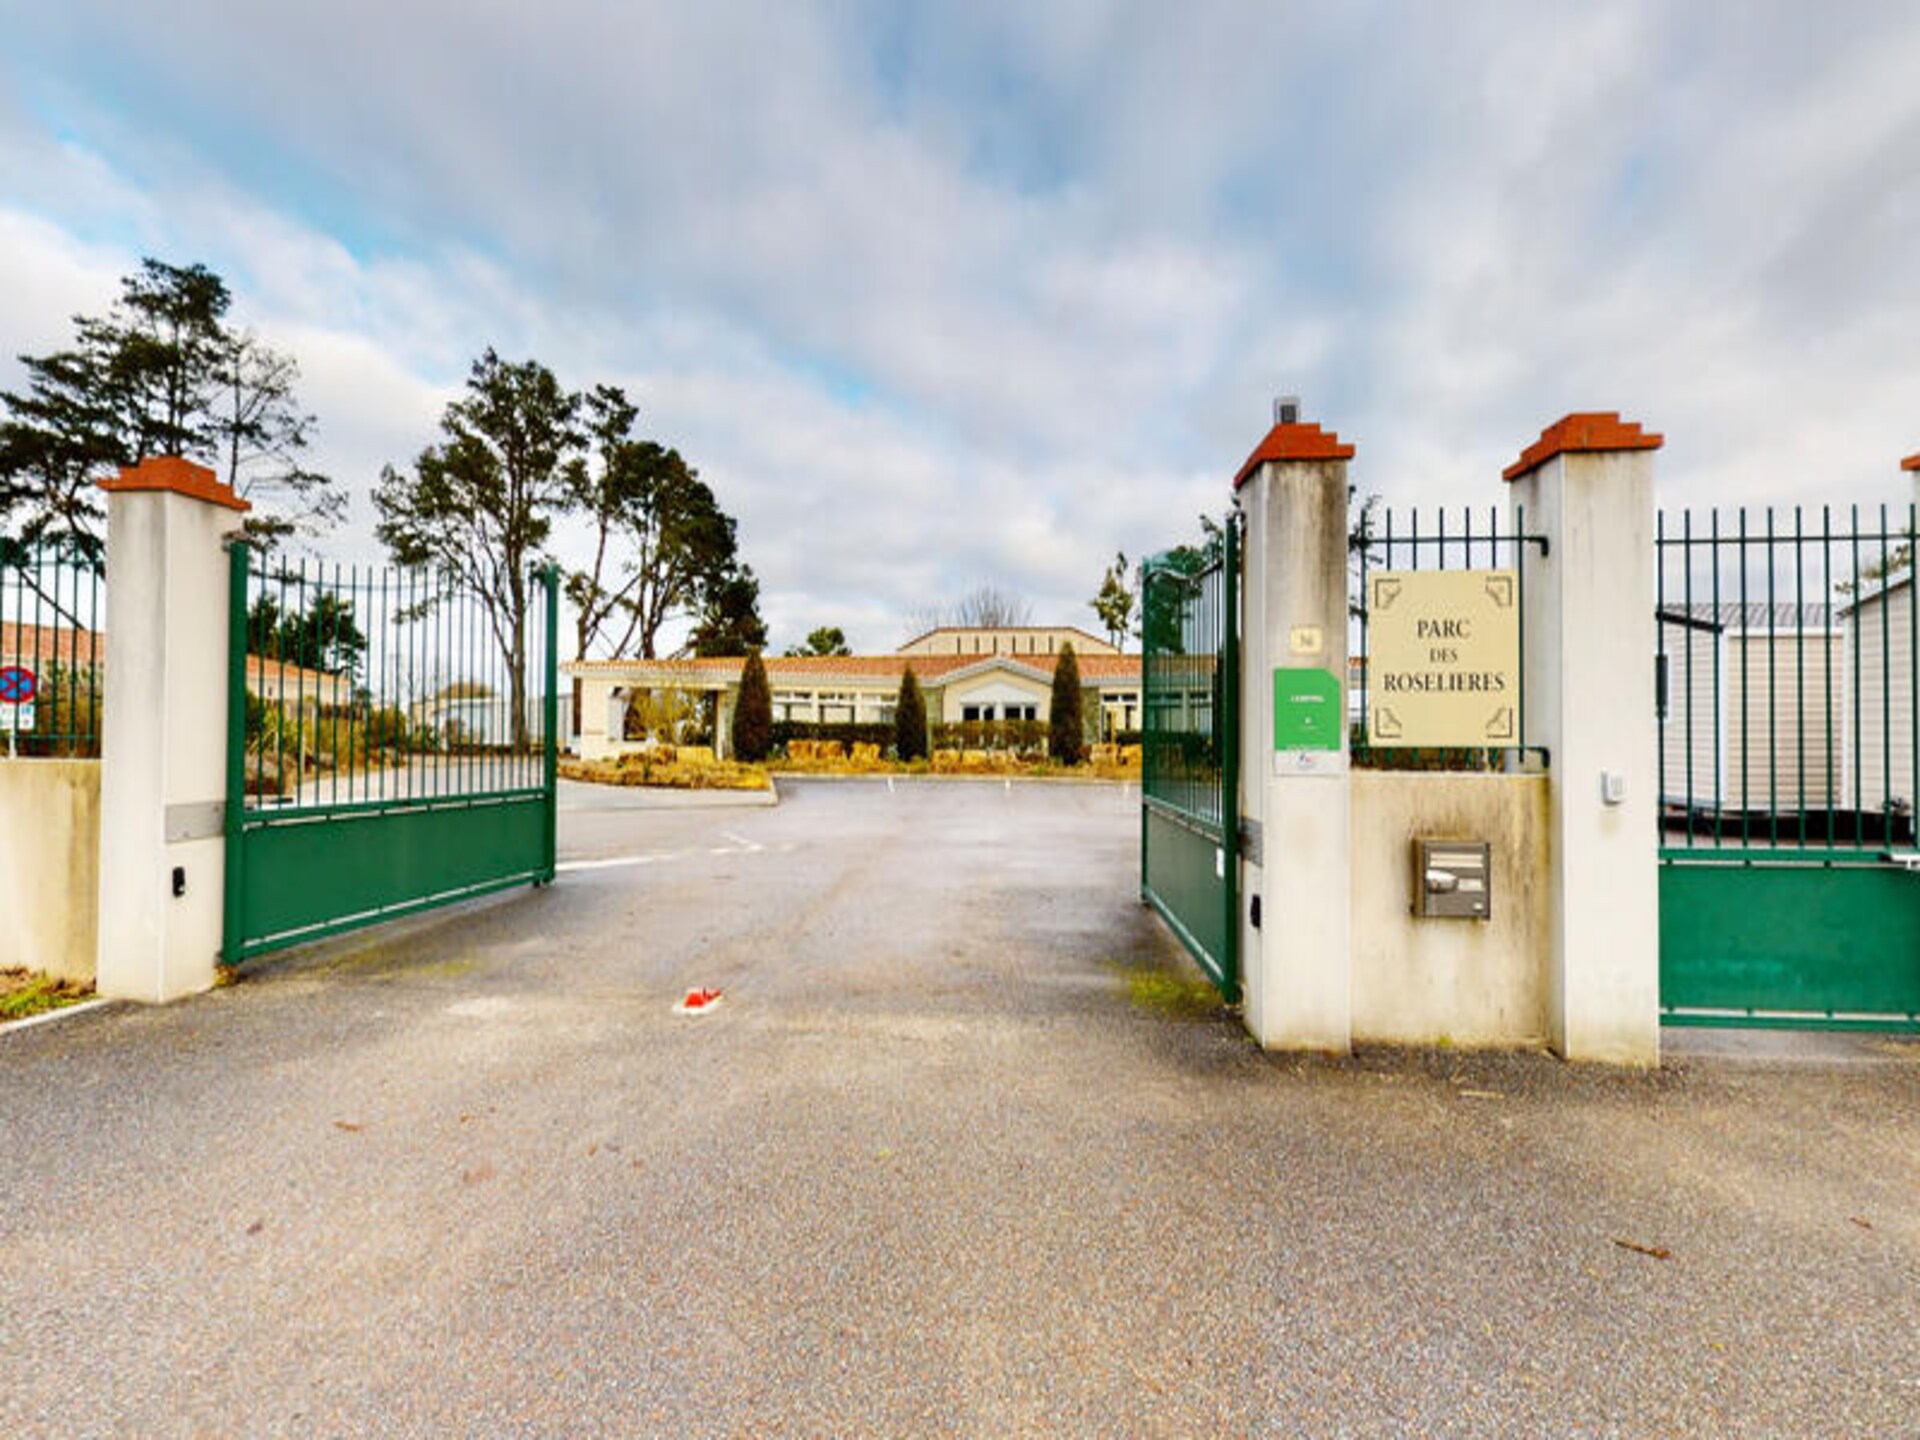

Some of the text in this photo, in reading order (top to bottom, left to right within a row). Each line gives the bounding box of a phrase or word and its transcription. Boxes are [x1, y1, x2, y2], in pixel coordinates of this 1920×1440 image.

[1417, 619, 1471, 638] PARC
[1429, 648, 1458, 662] DES
[1383, 672, 1505, 692] ROSELIERES
